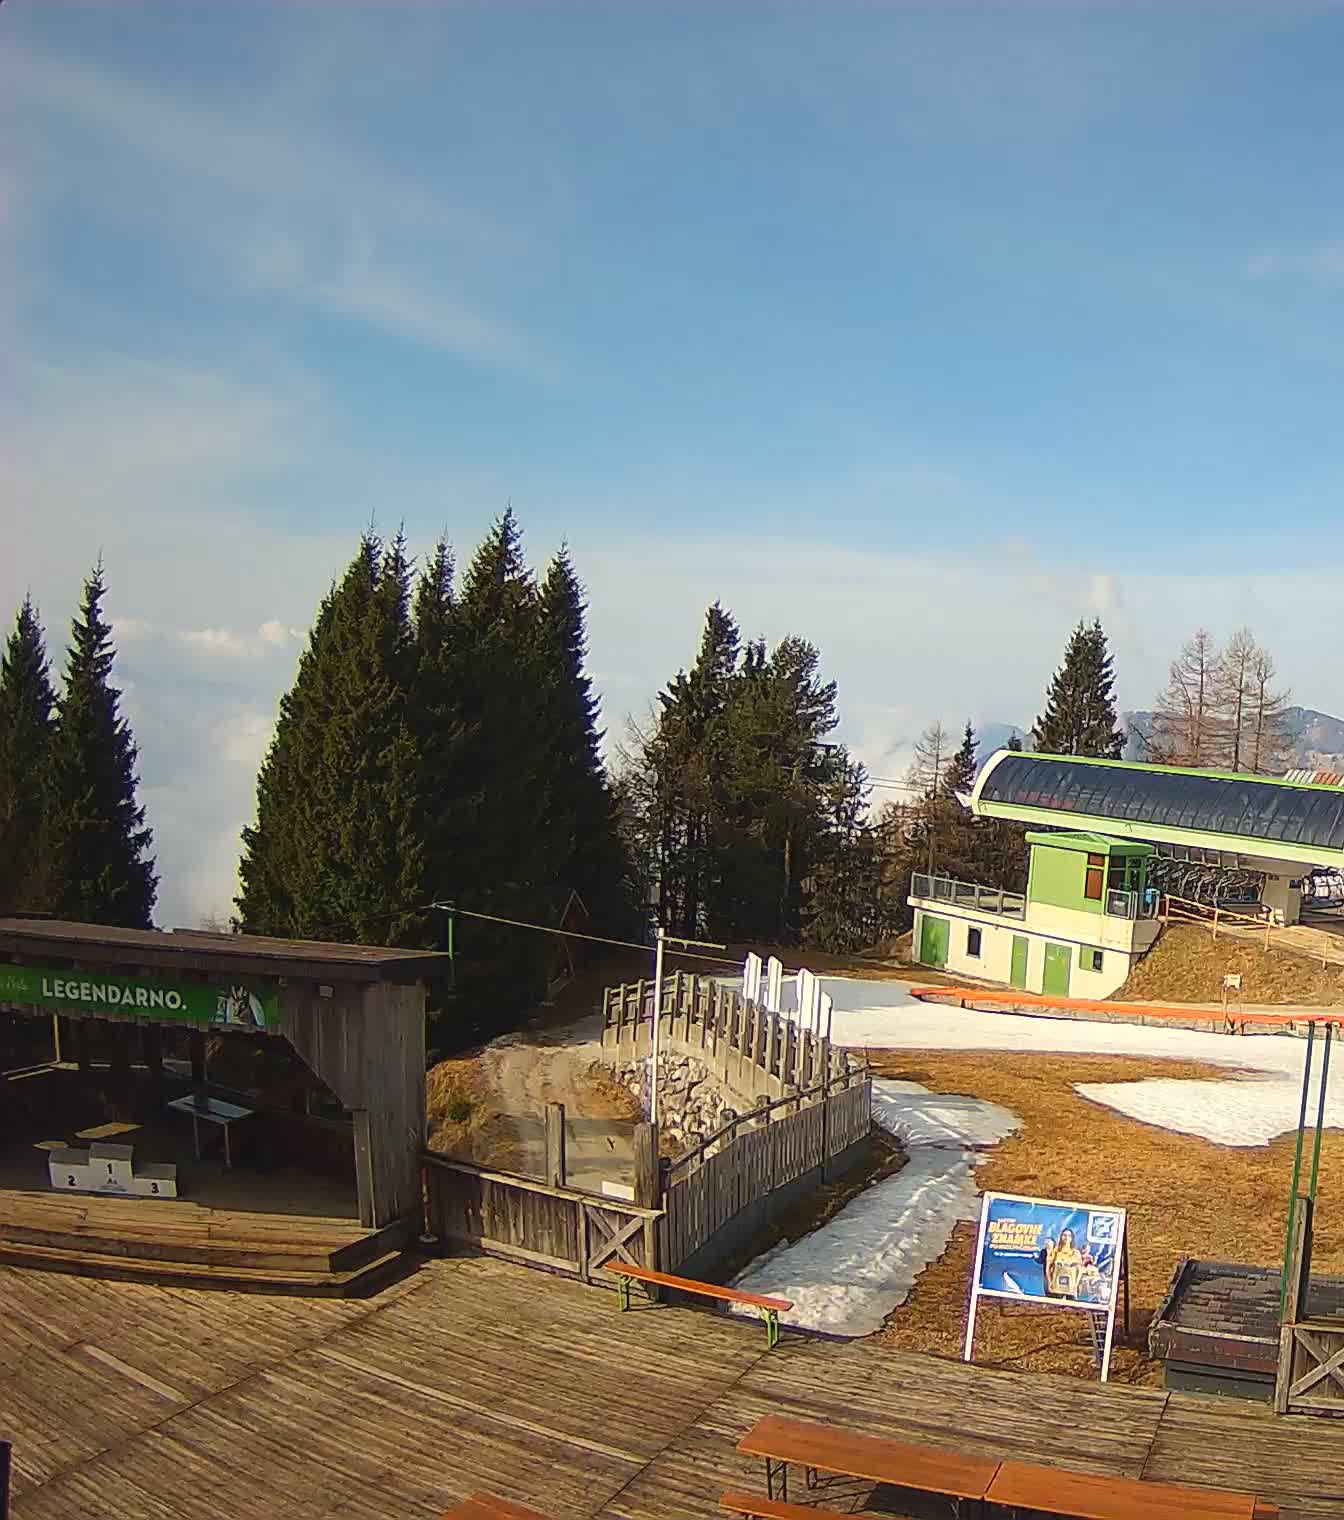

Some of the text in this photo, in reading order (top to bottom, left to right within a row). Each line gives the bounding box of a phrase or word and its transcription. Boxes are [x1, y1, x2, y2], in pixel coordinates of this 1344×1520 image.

[42, 977, 187, 1010] LEGENDARNO.
[107, 1163, 113, 1175] 1
[68, 1175, 76, 1187] 2
[151, 1182, 160, 1194] 3
